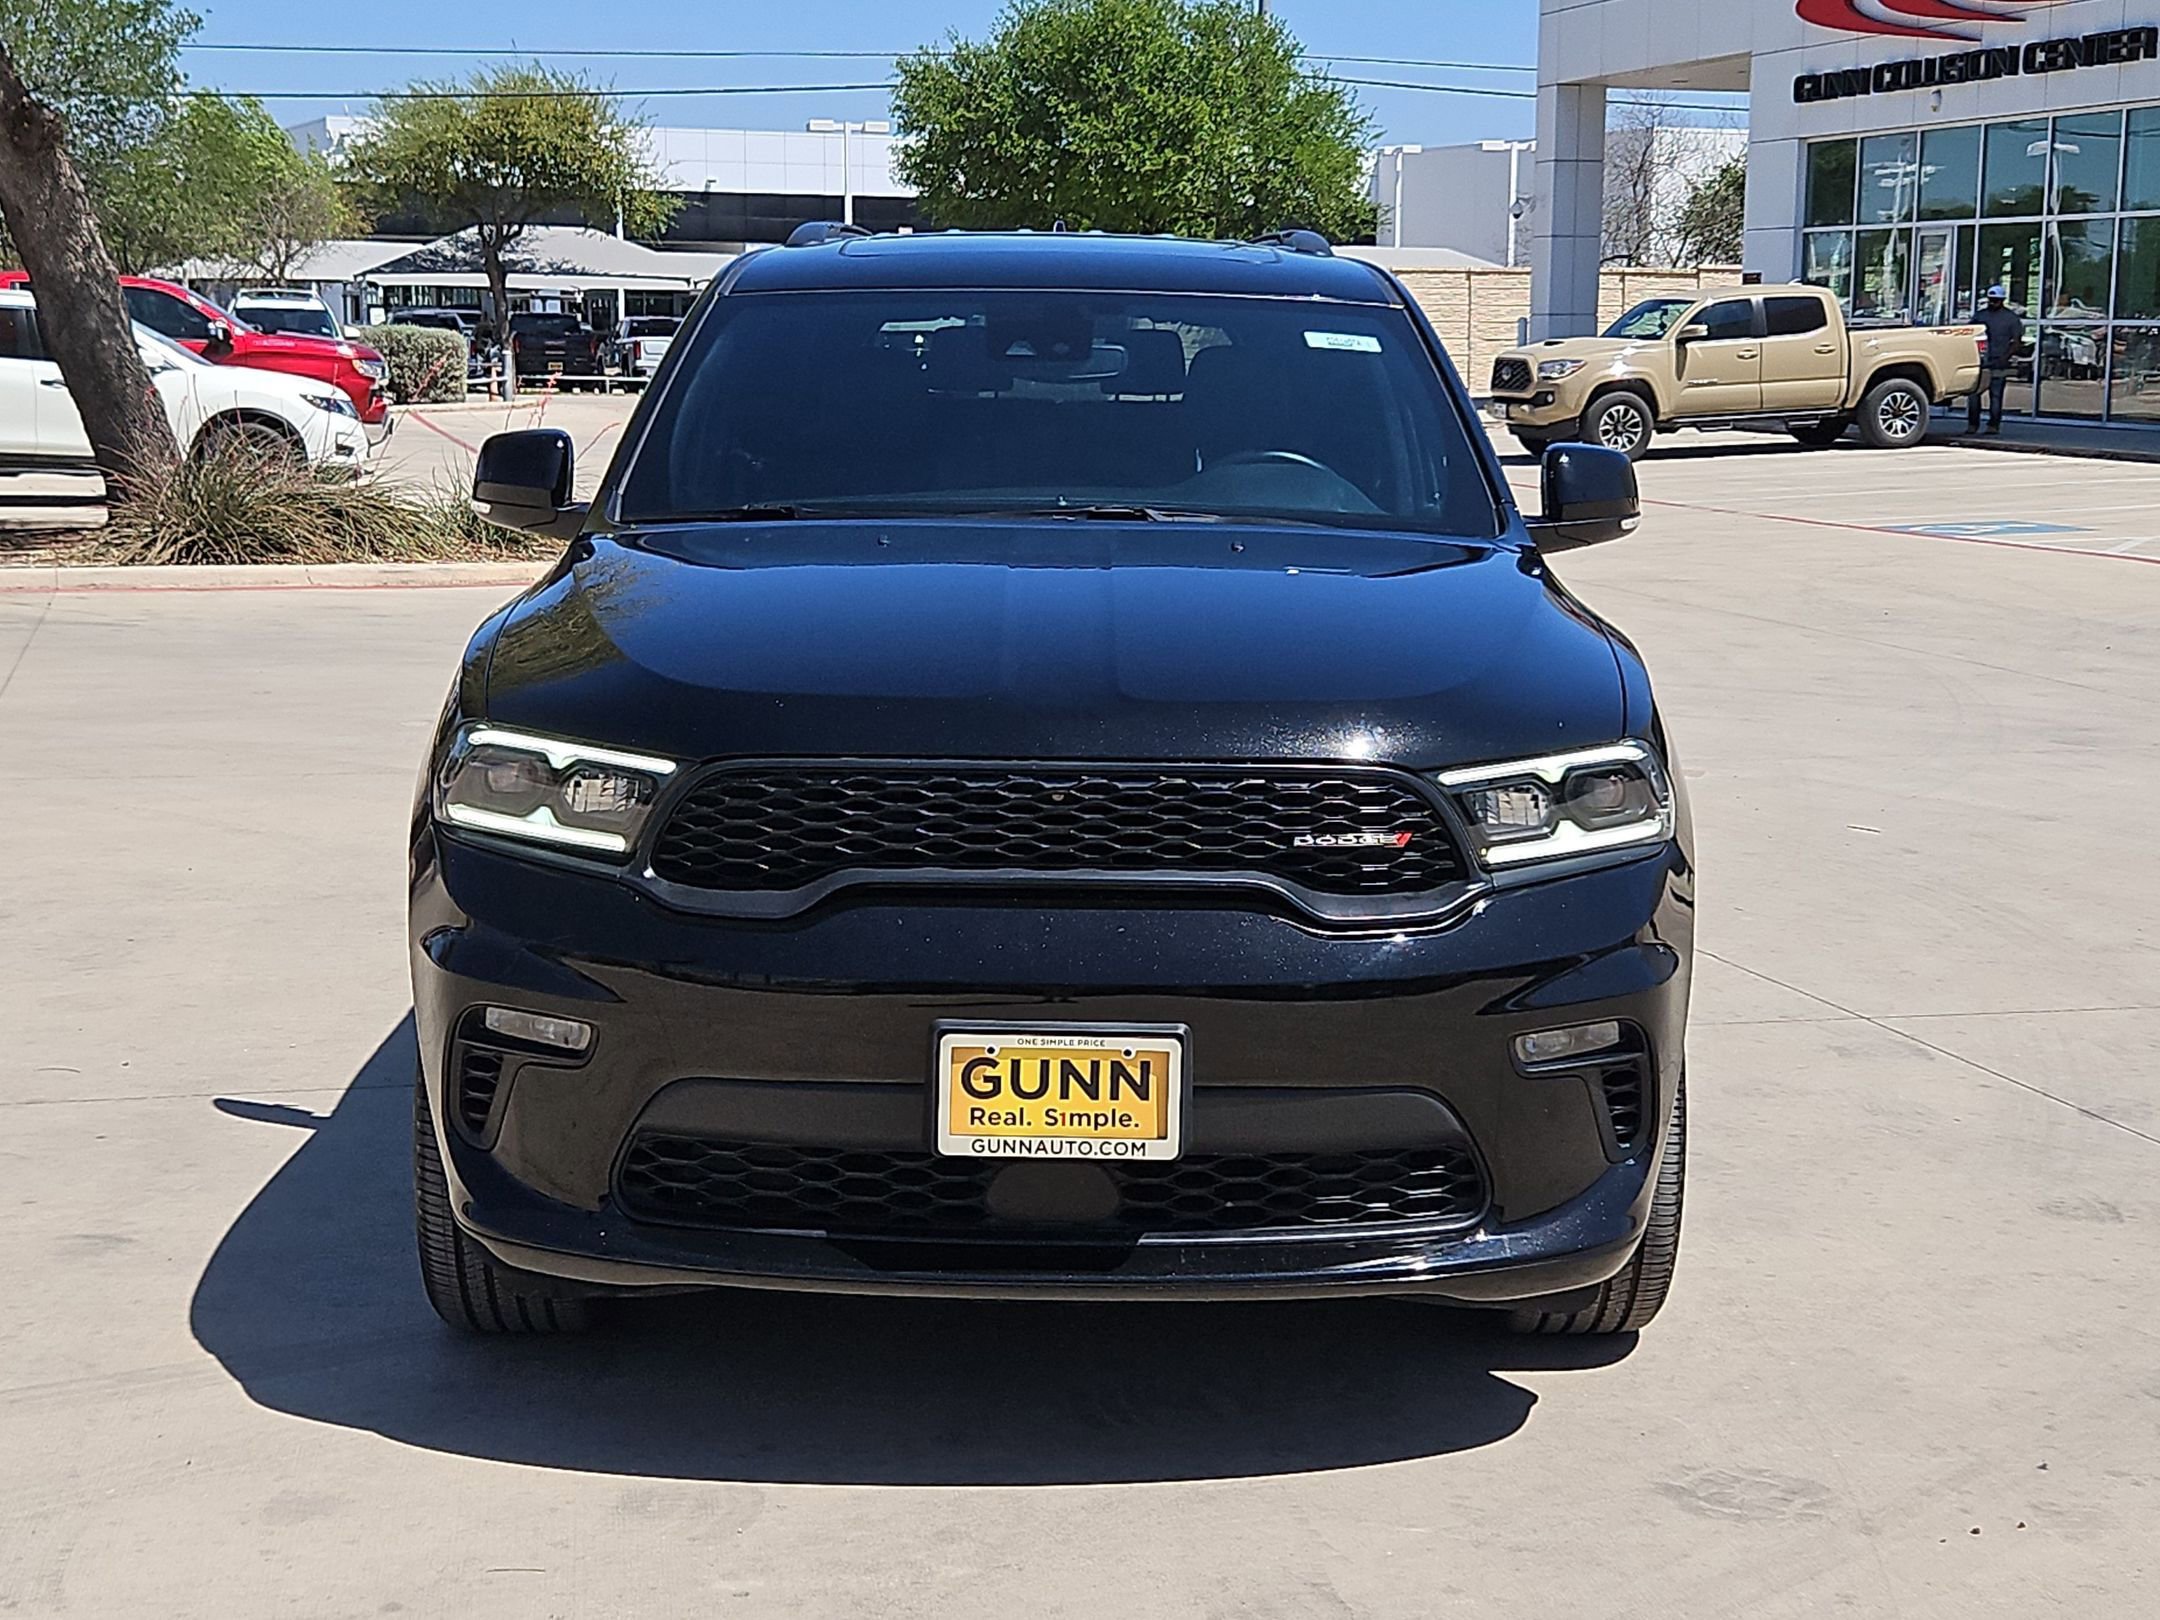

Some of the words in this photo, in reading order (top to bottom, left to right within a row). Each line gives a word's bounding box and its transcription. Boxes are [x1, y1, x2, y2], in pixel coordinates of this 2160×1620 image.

[1794, 67, 1872, 103] GUNN
[1872, 45, 2021, 94] COLLISION
[2022, 26, 2159, 75] CENTER
[1017, 1038, 1038, 1046] ONE
[1040, 1039, 1075, 1047] SIMPLE
[1077, 1039, 1105, 1048] PRICE
[961, 1057, 1150, 1101] GUNN
[970, 1107, 1032, 1126] Real.
[971, 1138, 1146, 1157] GUNNAUTO.COM
